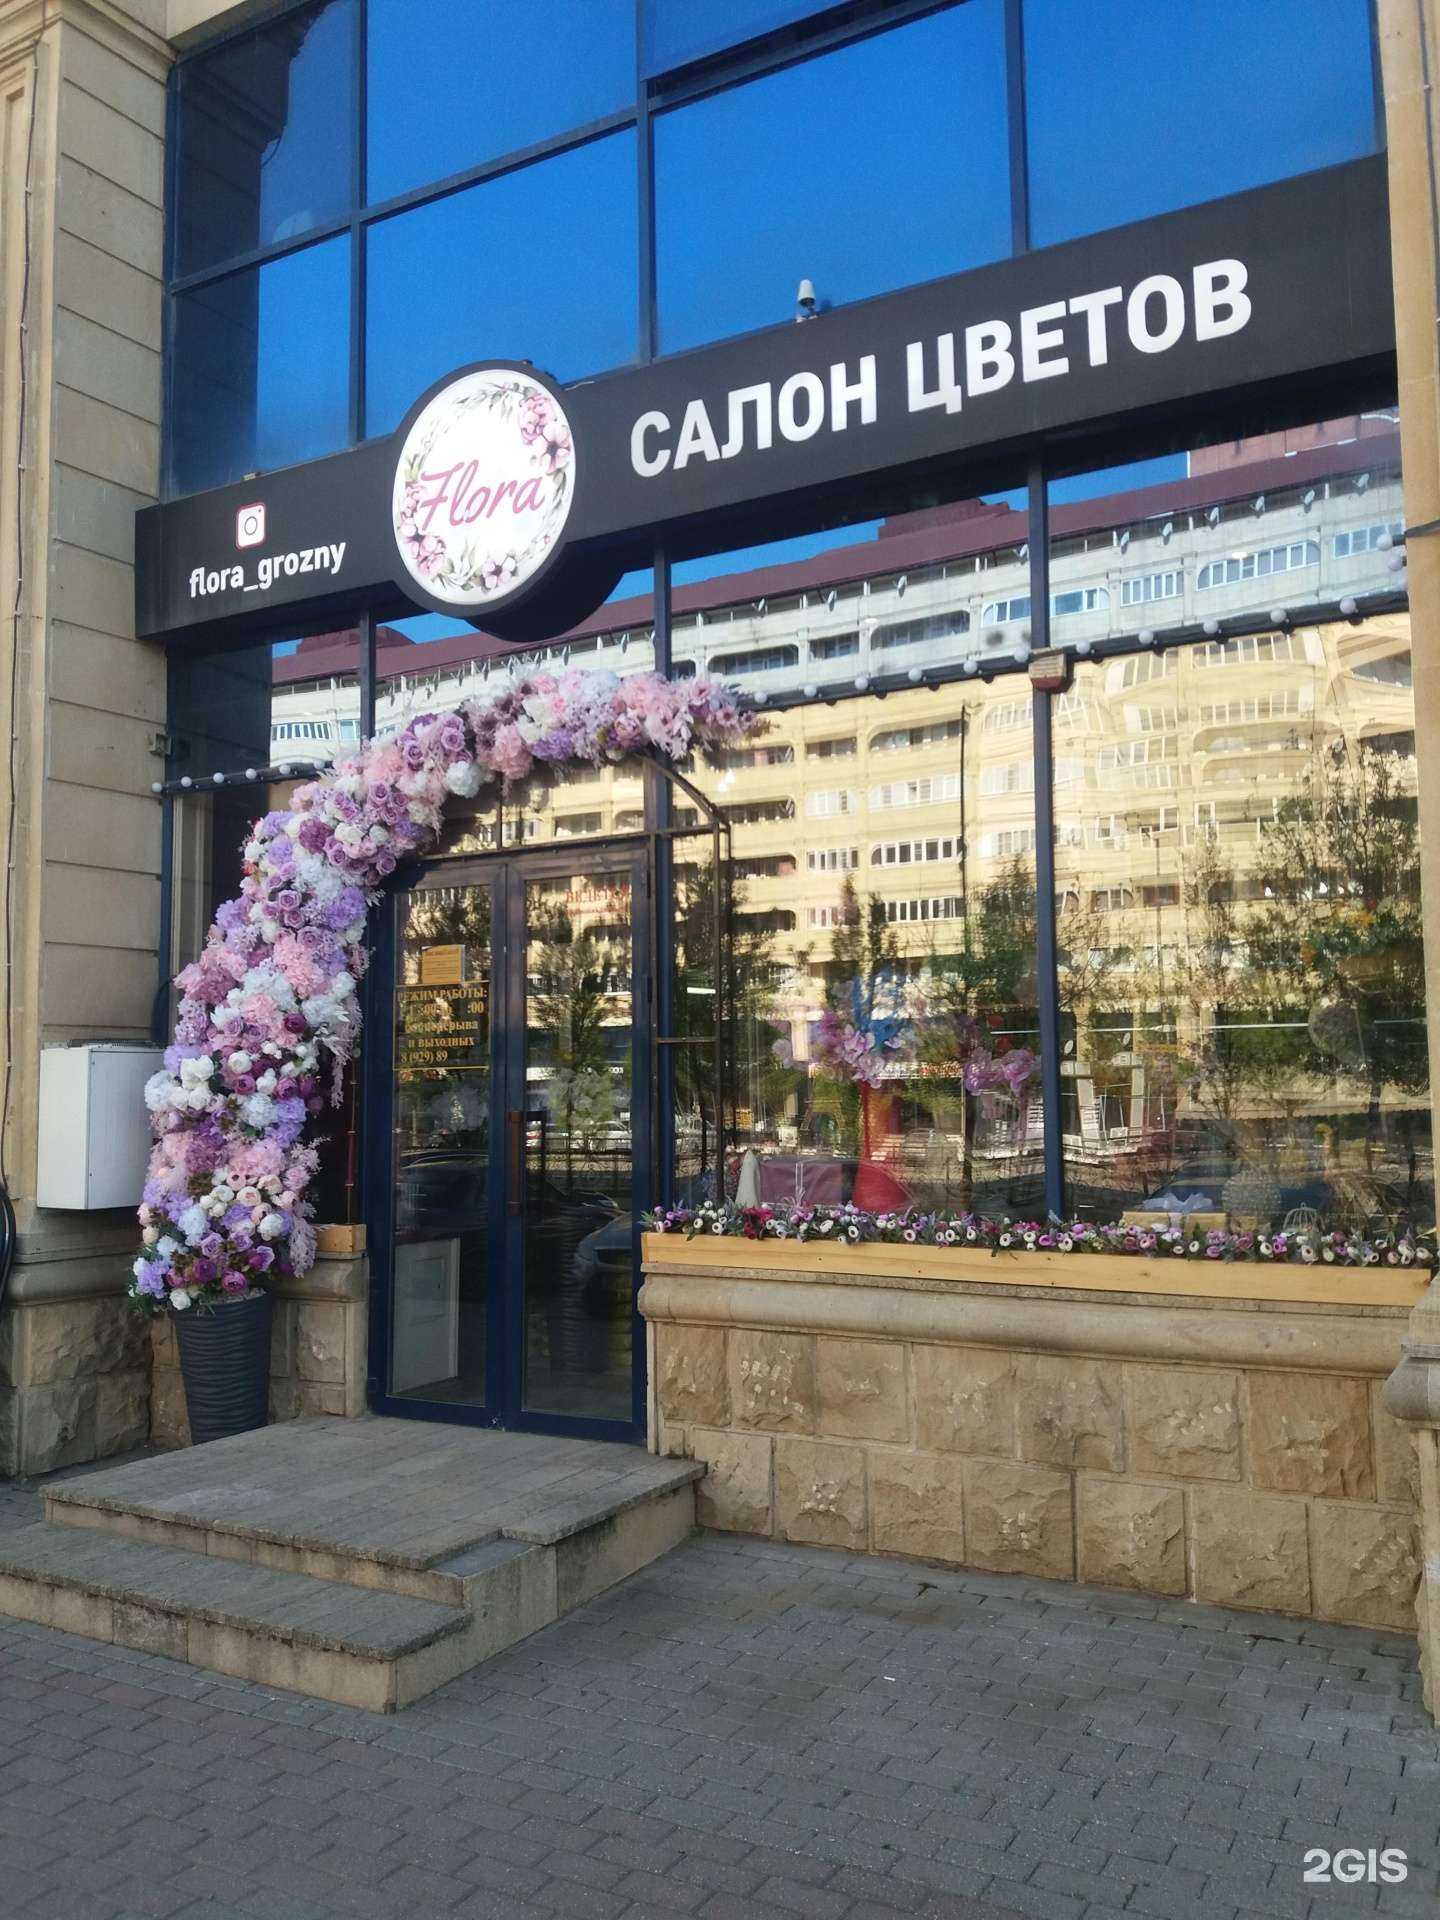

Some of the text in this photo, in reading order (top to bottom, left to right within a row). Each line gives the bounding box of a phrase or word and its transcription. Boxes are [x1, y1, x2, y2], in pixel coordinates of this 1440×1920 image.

[630, 259, 1252, 478] САЛОН ЦВЕТОВ
[420, 459, 546, 531] Flora
[189, 541, 347, 598] flora_grozny
[440, 987, 488, 1000] РАБОТЫ:
